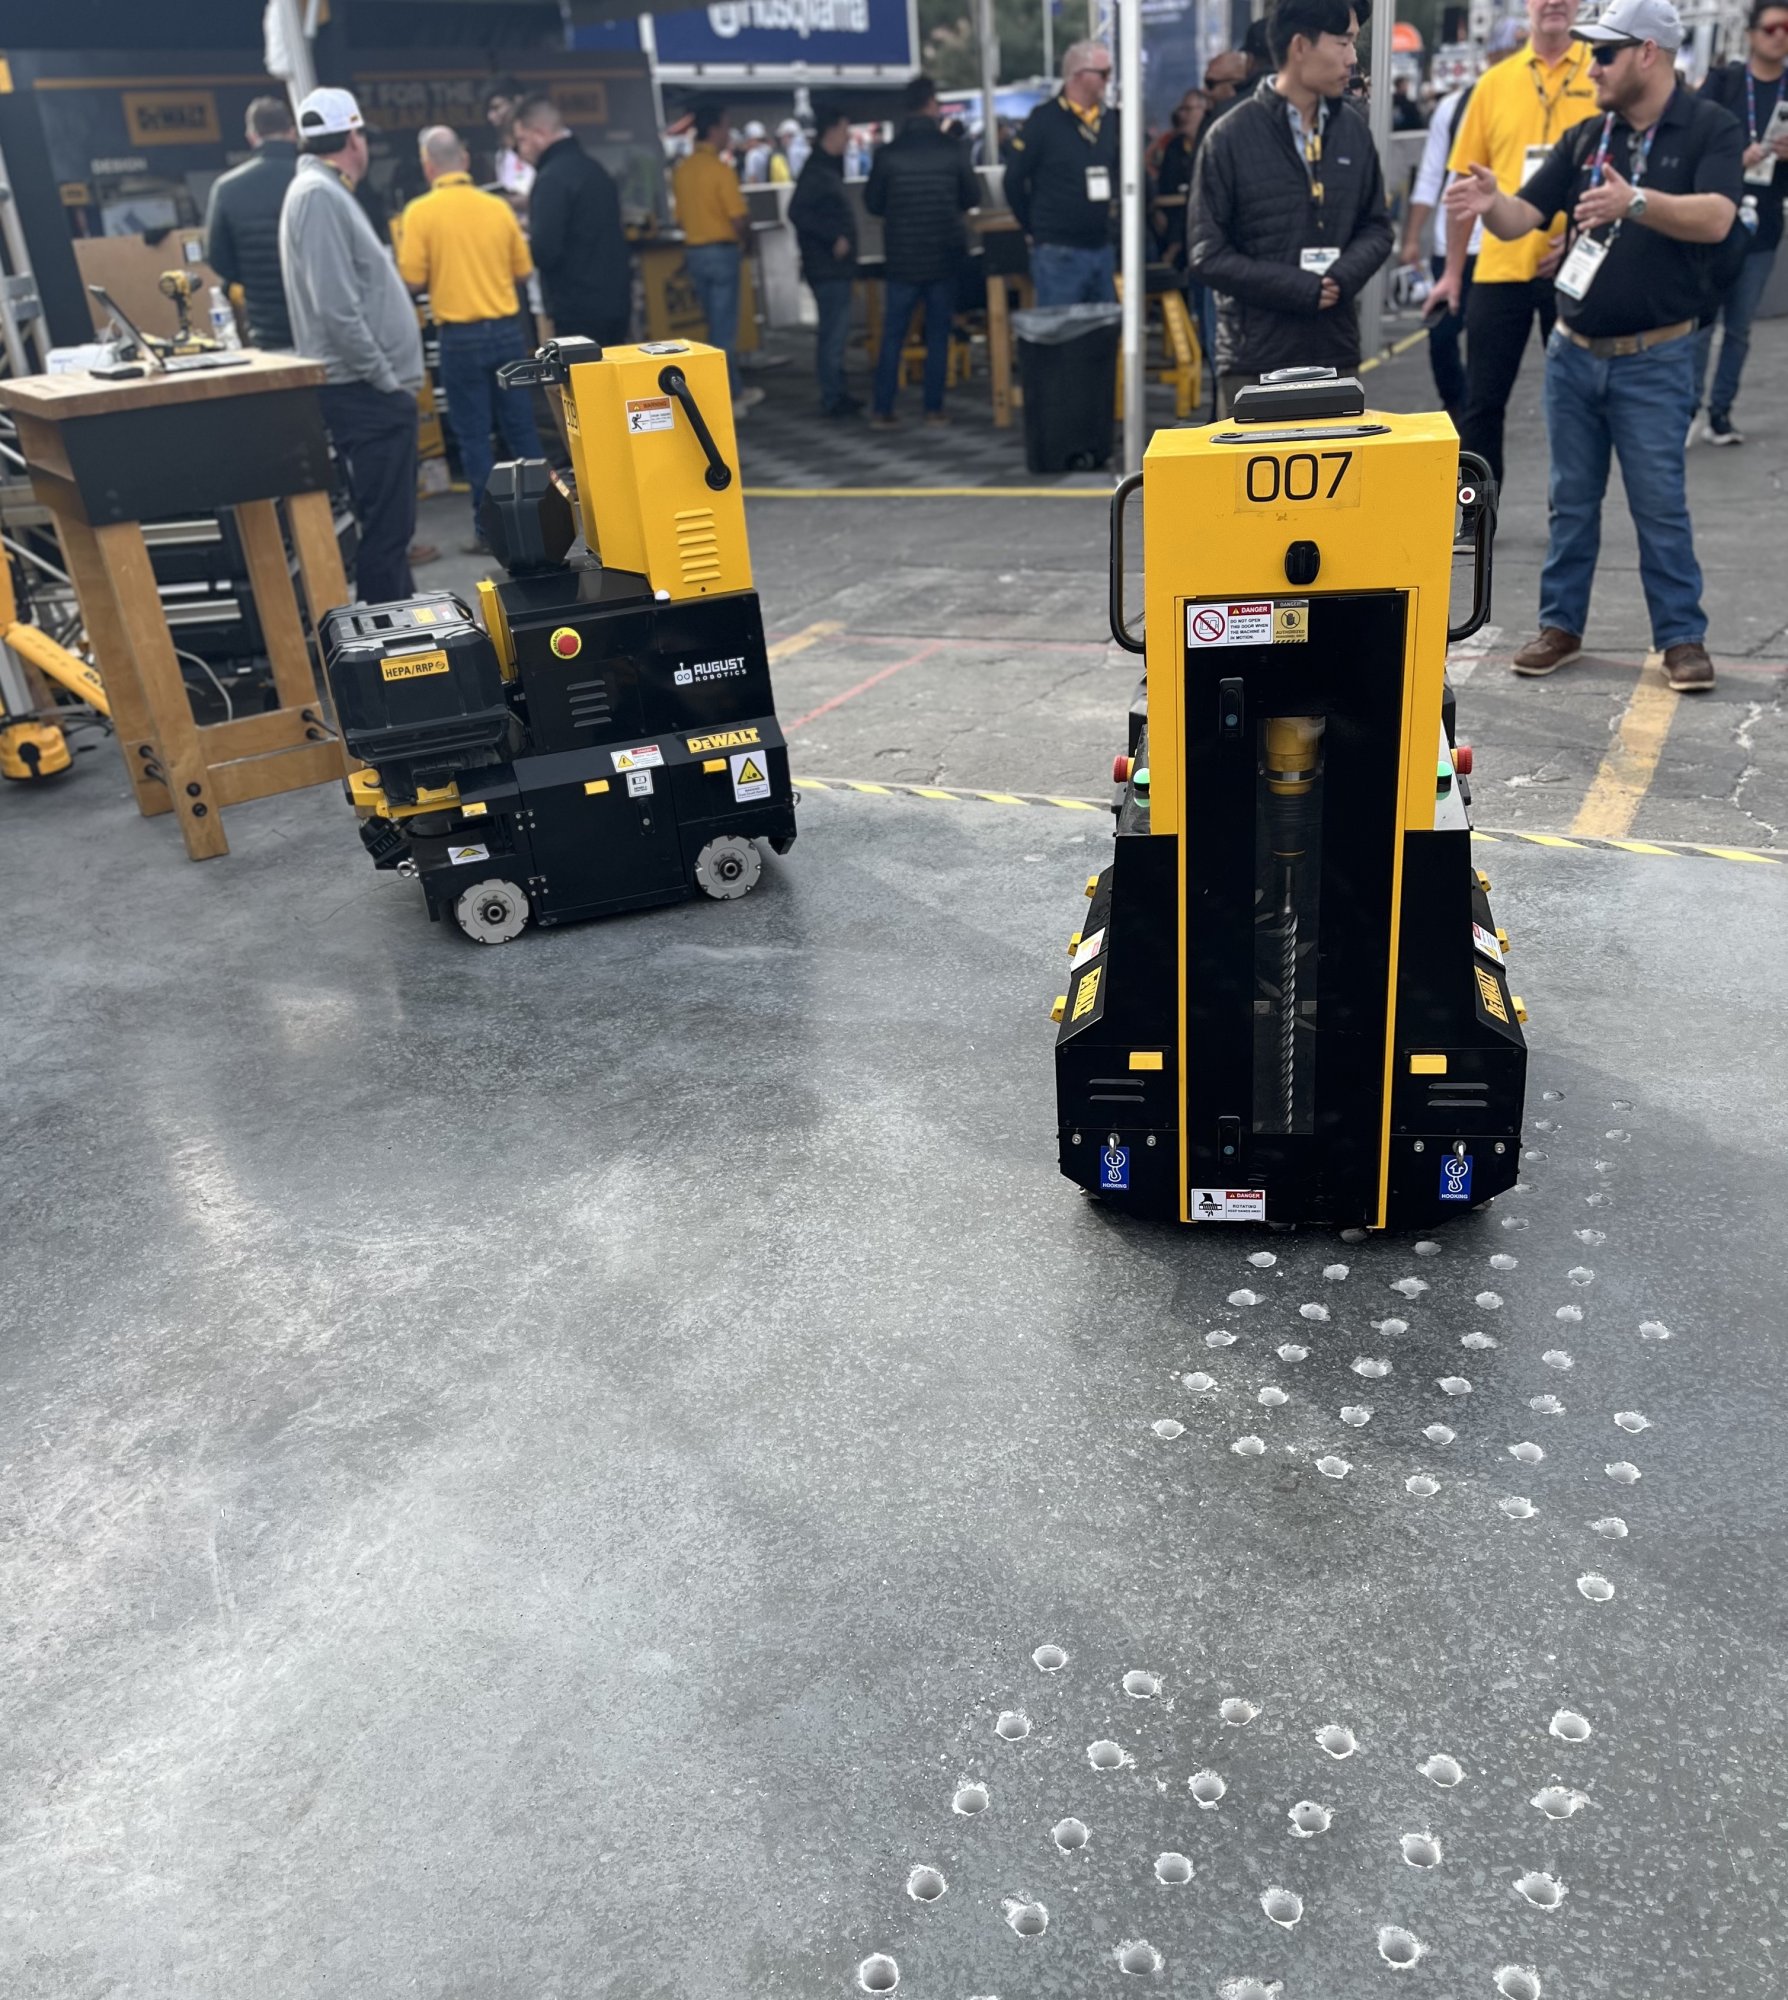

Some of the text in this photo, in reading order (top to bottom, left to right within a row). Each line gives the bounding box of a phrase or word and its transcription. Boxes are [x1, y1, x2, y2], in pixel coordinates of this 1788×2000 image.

[1246, 451, 1353, 502] 007
[1241, 606, 1268, 614] DANGER
[385, 662, 434, 678] HEPA/RRP
[693, 657, 745, 675] AUGUST
[695, 668, 747, 682] ROBOTICS
